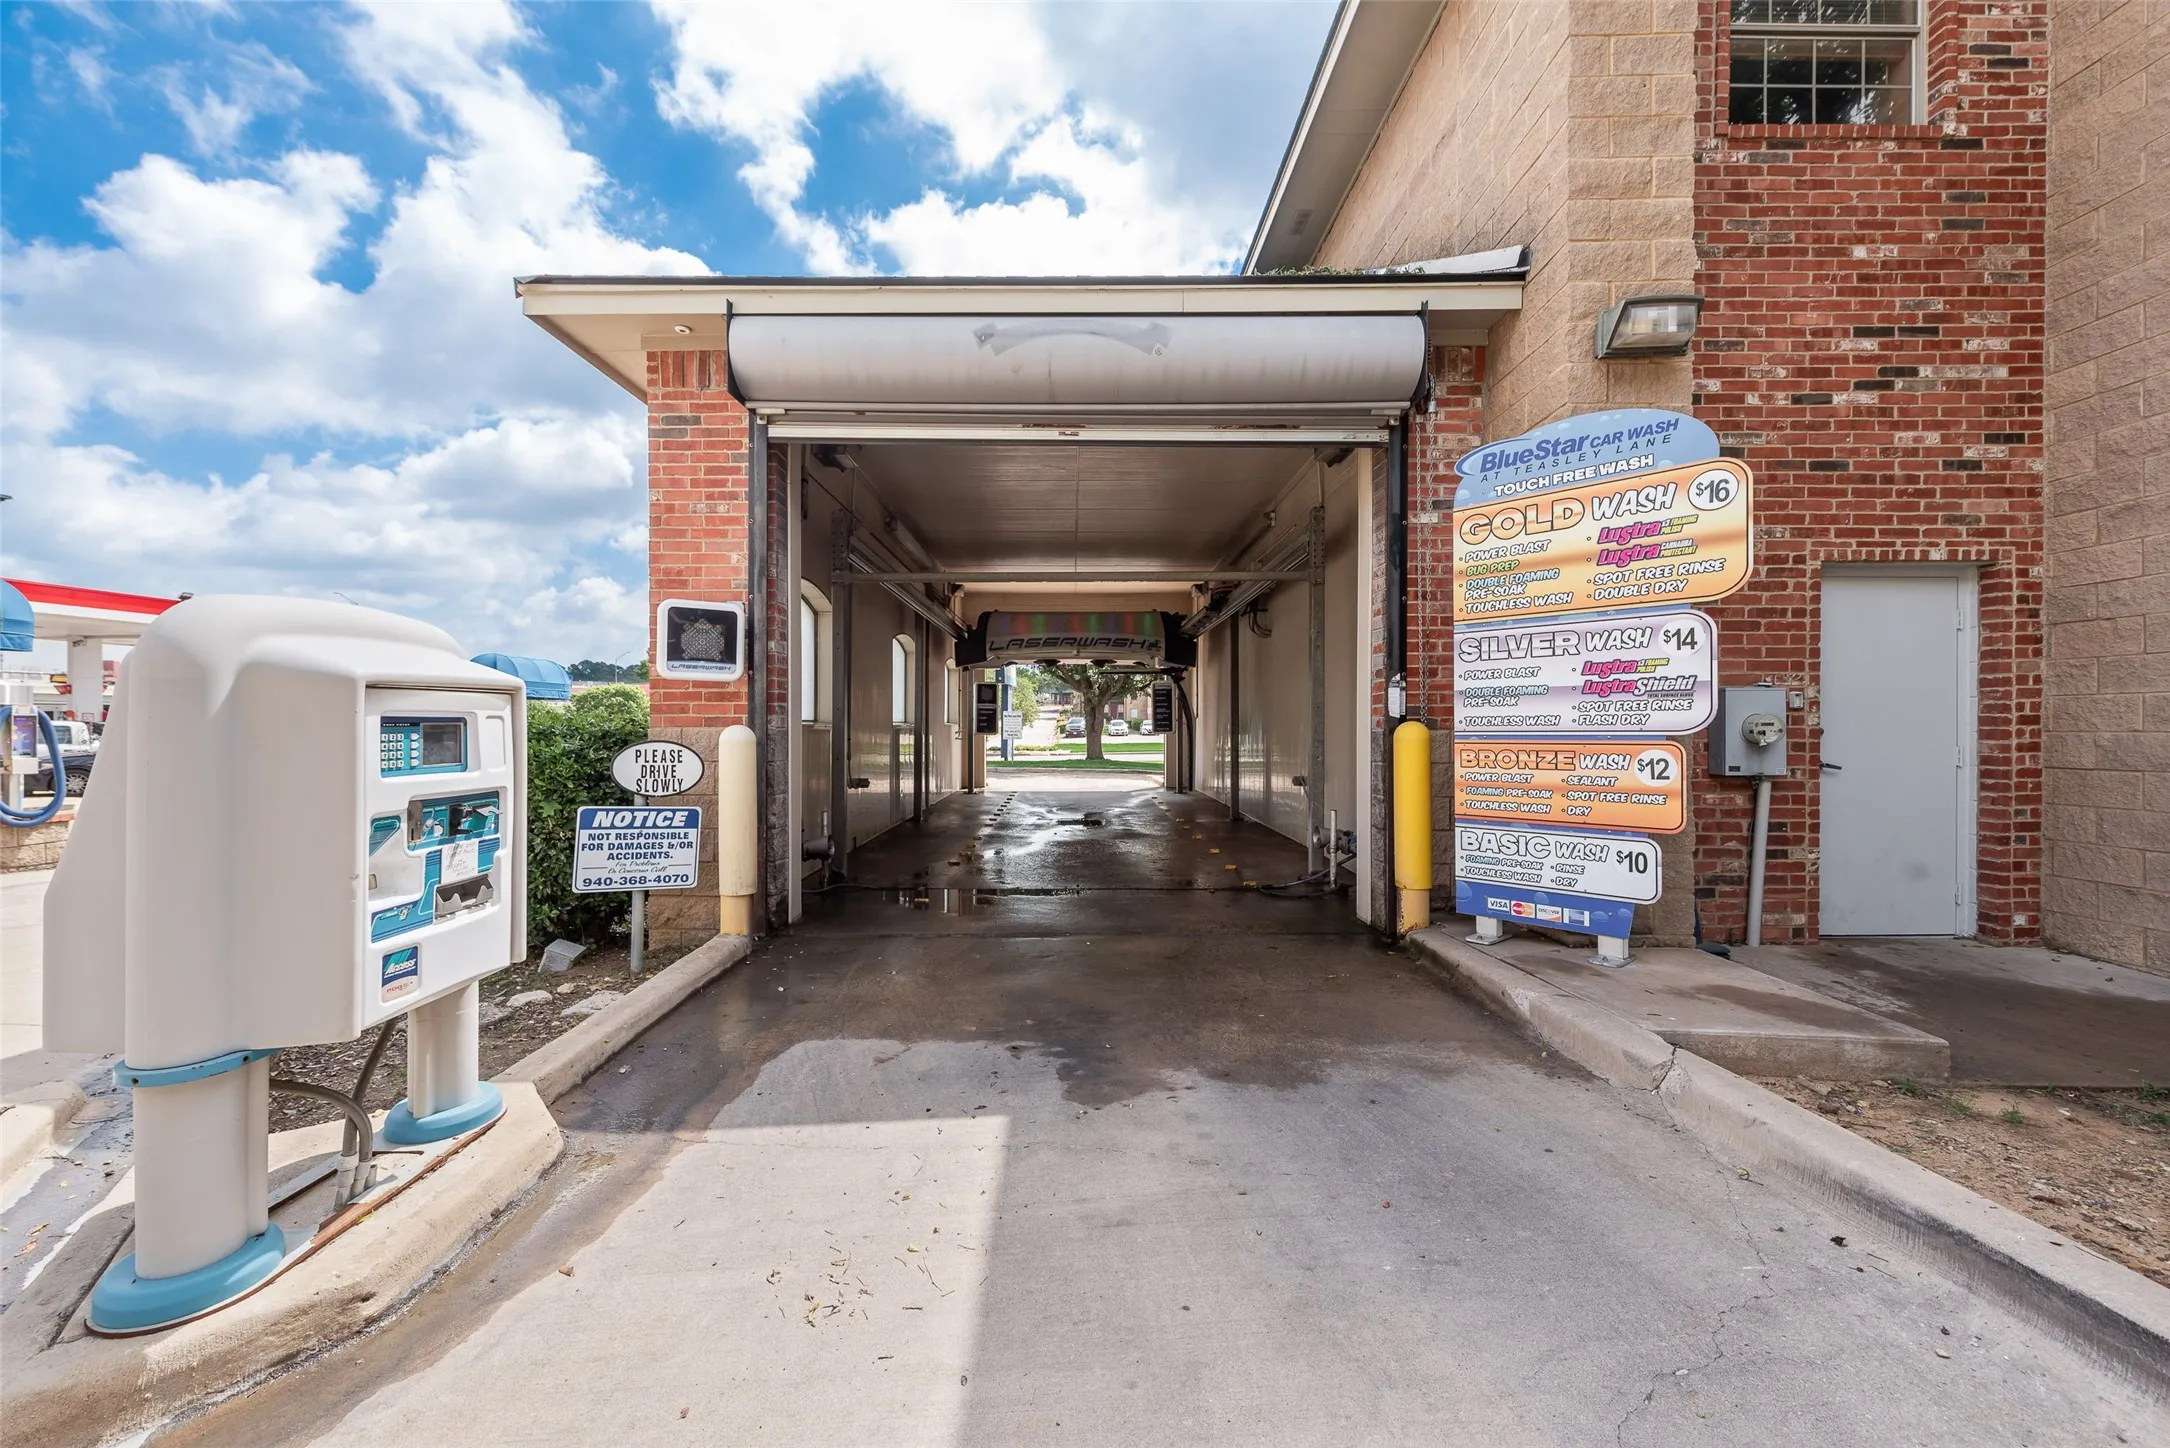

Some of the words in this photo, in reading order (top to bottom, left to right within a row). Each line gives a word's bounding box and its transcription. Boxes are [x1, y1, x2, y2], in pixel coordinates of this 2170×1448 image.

[1480, 433, 1590, 473] BlueStar
[1590, 431, 1623, 448] CAR
[1627, 418, 1680, 440] WASH
[1481, 471, 1501, 483] AT
[1515, 449, 1601, 475] TEASLEY
[1616, 434, 1672, 454] LANE
[1494, 476, 1550, 497] TOUCH
[1552, 465, 1596, 486] FREE
[1599, 453, 1655, 475] WASH
[1695, 478, 1731, 504] $16
[1459, 497, 1585, 545] GOLD
[1591, 482, 1677, 521] WASH
[1597, 521, 1661, 545] Lustra
[1465, 546, 1508, 563] POWER
[1510, 539, 1551, 556] BLAST
[1597, 544, 1660, 567] Lustra
[1466, 564, 1487, 576] BUG
[1490, 559, 1520, 573] PREP
[1593, 570, 1633, 586] SPOT
[1636, 564, 1675, 580] FREE
[1678, 558, 1726, 574] RINSE
[1466, 575, 1507, 590] DOUBLE
[1509, 568, 1560, 584] FOAMING
[1465, 583, 1527, 601] PRE-SOAK
[1594, 584, 1651, 600] DOUBLE
[1654, 579, 1689, 594] DRY
[1465, 597, 1531, 614] TOUCHLESS
[1534, 591, 1574, 607] WASH
[988, 636, 1146, 651] LASERWASH
[1458, 630, 1581, 663] SILVER
[1585, 627, 1653, 651] WASH
[1663, 627, 1698, 651] $14
[1464, 669, 1501, 681] POWER
[1503, 666, 1541, 678] BLAST
[1581, 659, 1638, 679] Lustra
[1465, 686, 1501, 697] DOUBLE
[1503, 685, 1549, 696] FOAMING
[1582, 675, 1698, 698] LustraShield
[1463, 697, 1520, 708] PRE-SOAK
[1578, 700, 1613, 712] SPOT
[1615, 700, 1649, 711] FREE
[1651, 699, 1694, 711] RINSE
[1464, 716, 1523, 727] TOUCHLESS
[1523, 715, 1561, 726] WASH
[1578, 714, 1618, 726] FLASH
[1620, 714, 1650, 725] DRY
[635, 749, 683, 764] PLEASE
[1459, 748, 1576, 771] BRONZE
[1578, 752, 1632, 771] WASH
[641, 764, 676, 779] DRIVE
[1637, 757, 1671, 781] $12
[636, 778, 684, 792] SLOWLY
[1464, 772, 1500, 783] POWER
[1501, 773, 1534, 784] BLAST
[1566, 776, 1619, 787] SEALANT
[1466, 786, 1504, 797] FOAMING
[1505, 788, 1554, 800] PRE-SOAK
[1566, 790, 1598, 802] SPOT
[1599, 792, 1629, 803] FREE
[1631, 793, 1668, 805] RINSE
[1465, 800, 1519, 813] TOUCHLESS
[1519, 802, 1551, 815] WASH
[1567, 805, 1592, 817] DRY
[592, 810, 689, 828] NOTICE
[588, 833, 612, 841] NOT
[615, 832, 689, 841] RESPONSIBLE
[581, 842, 604, 852] FOR
[608, 842, 664, 850] DAMAGES
[667, 841, 694, 850] &/OR
[1459, 830, 1551, 859] BASIC
[1554, 840, 1610, 864] WASH
[607, 851, 673, 861] ACCIDENTS.
[1465, 854, 1500, 866] FOAMING
[1501, 857, 1544, 871] PRE-SOAK
[1616, 850, 1648, 875] $10
[1464, 866, 1514, 881] TOUCHLESS
[1513, 870, 1542, 884] WASH
[1555, 862, 1585, 876] RINSE
[582, 874, 689, 887] 940-368-4070
[1555, 876, 1578, 888] DRY
